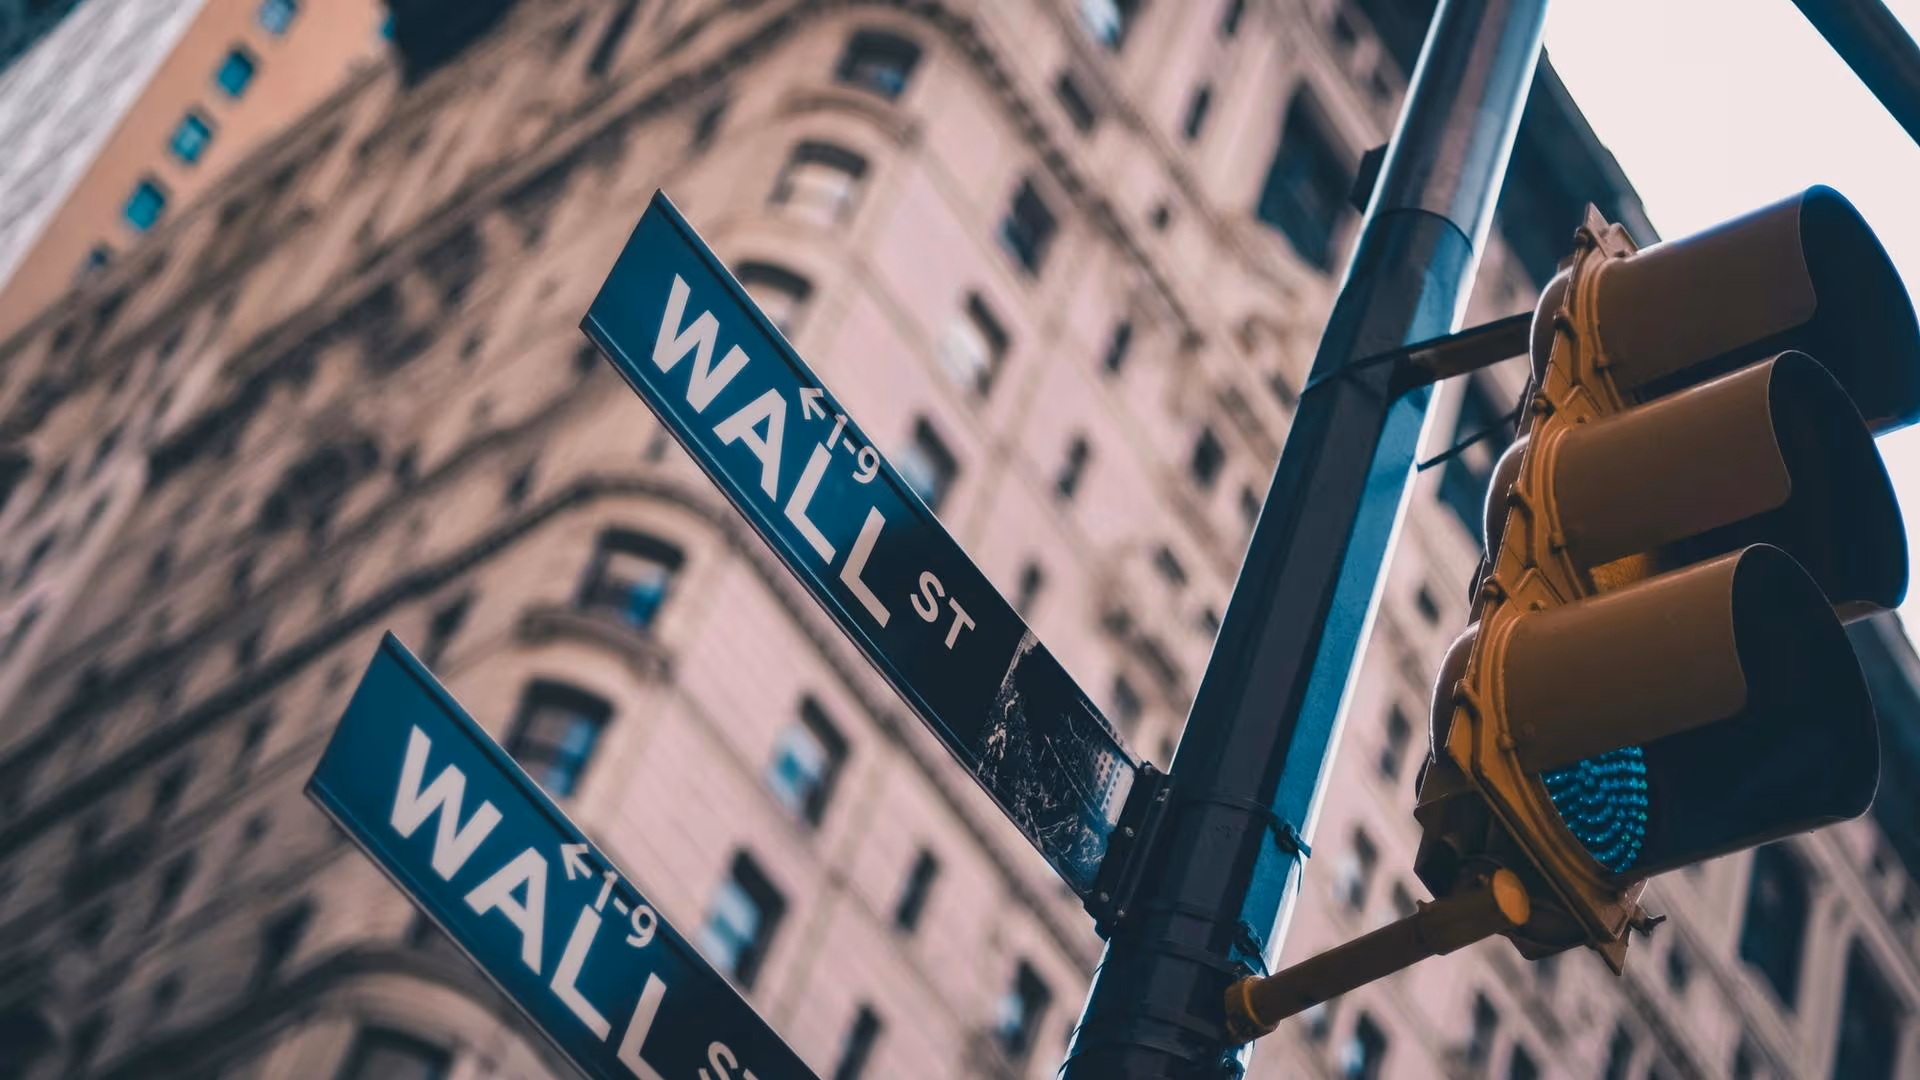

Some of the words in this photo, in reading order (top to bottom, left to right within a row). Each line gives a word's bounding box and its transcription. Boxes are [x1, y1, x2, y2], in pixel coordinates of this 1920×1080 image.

[652, 273, 891, 628] WALL
[910, 571, 976, 649] ST
[826, 415, 881, 484] 1-9
[390, 724, 667, 1080] WALL
[698, 1041, 760, 1080] S
[595, 872, 658, 948] 1-9
